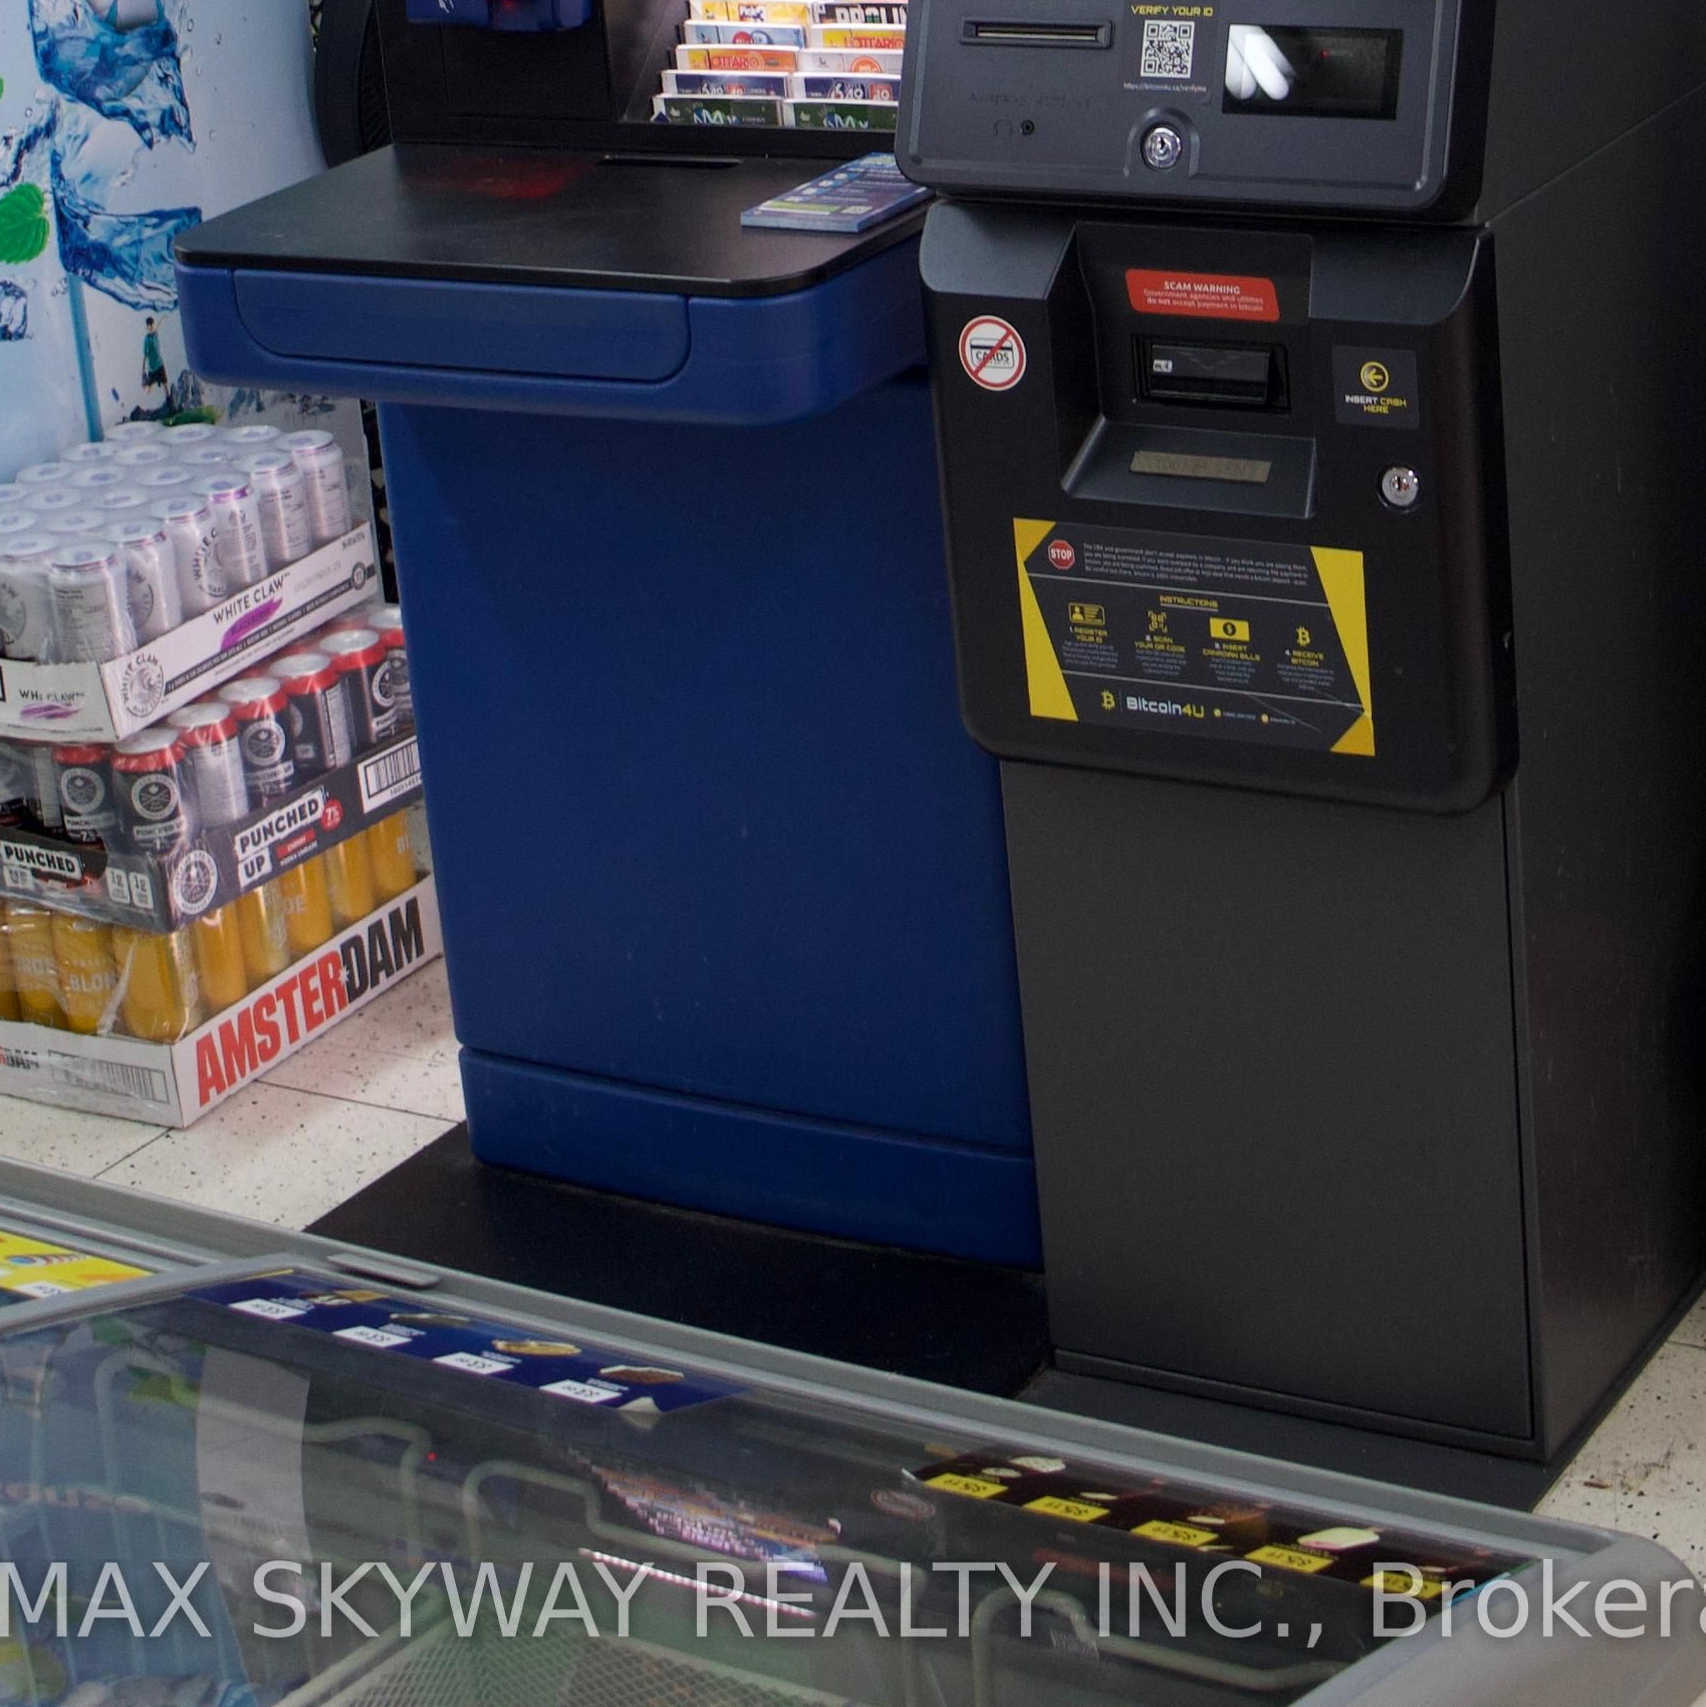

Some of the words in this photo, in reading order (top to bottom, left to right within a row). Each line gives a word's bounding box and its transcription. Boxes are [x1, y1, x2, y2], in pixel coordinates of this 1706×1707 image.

[1131, 4, 1170, 16] VERIFY
[1172, 6, 1201, 17] YOUR
[1203, 6, 1214, 18] ID
[1164, 280, 1191, 292] SCAM
[1193, 282, 1241, 295] WARNING
[1345, 394, 1378, 405] INSERT
[1380, 397, 1407, 407] CASH
[1363, 404, 1389, 415] HERE
[1050, 546, 1073, 561] STOP
[212, 595, 252, 625] WHITE
[253, 577, 286, 604] CLAW
[1159, 595, 1219, 609] INSTRUCTIONS
[1126, 695, 1206, 719] Bitcoin4U
[239, 798, 320, 853] PUNCHED
[4, 845, 77, 873] PUNCHED
[244, 853, 267, 877] UP
[196, 897, 426, 1109] AMSTERDAM
